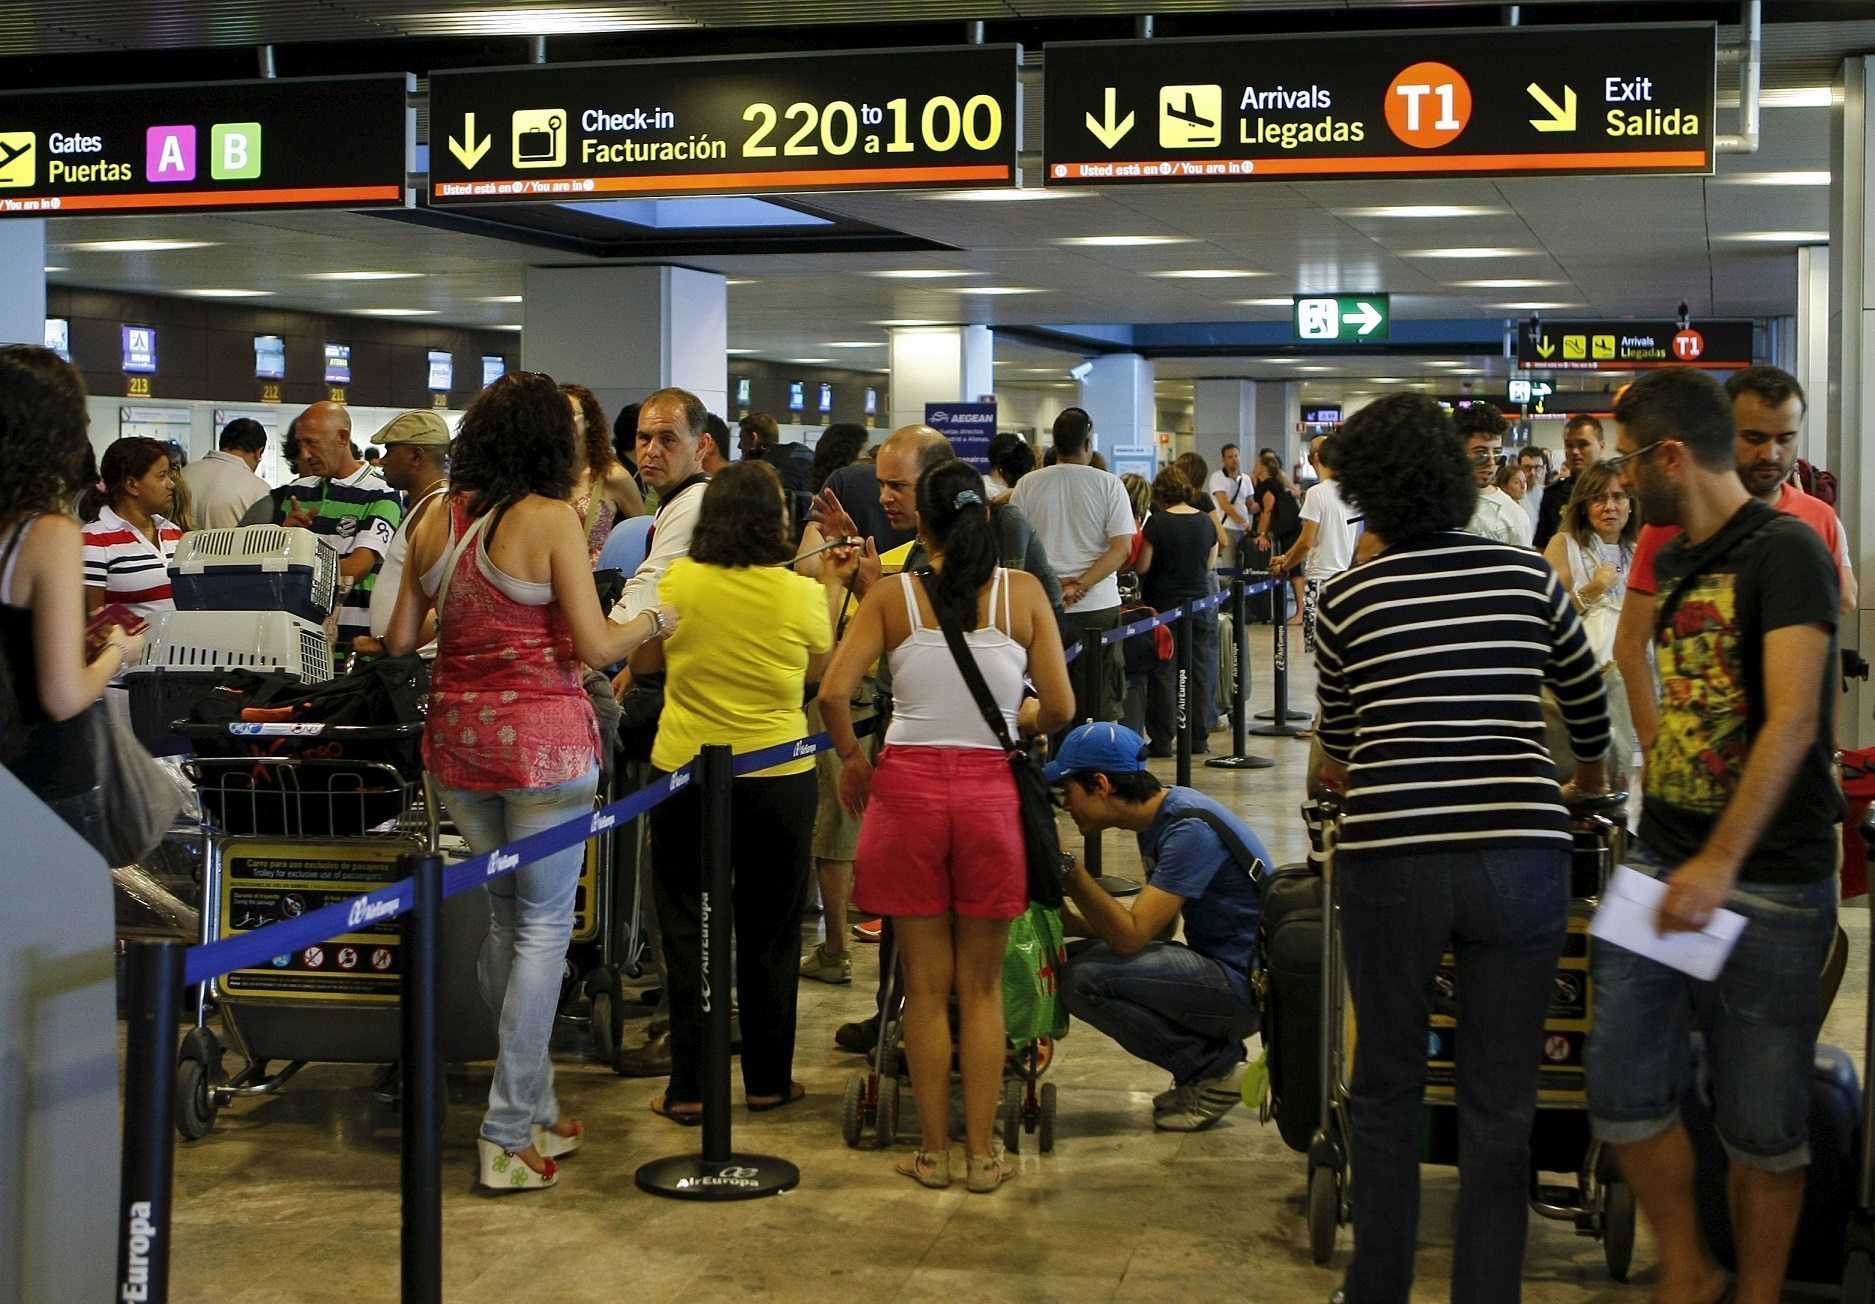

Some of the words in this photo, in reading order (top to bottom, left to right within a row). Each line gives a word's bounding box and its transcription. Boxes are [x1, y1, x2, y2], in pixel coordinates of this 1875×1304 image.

[1605, 76, 1652, 102] Exit
[861, 103, 883, 125] to
[1240, 84, 1332, 110] Arrivals
[1396, 83, 1461, 132] T1
[581, 107, 674, 132] Check-in
[741, 101, 858, 159] 220
[885, 94, 1003, 153] 100
[1606, 107, 1700, 138] Salida
[1239, 115, 1365, 148] Llegadas
[48, 132, 102, 154] Gates
[157, 135, 186, 173] A
[223, 132, 250, 171] B
[582, 134, 726, 163] Facturación
[863, 135, 880, 155] a
[48, 159, 132, 184] Puertas
[1079, 164, 1113, 177] Usted
[1115, 163, 1141, 175] está
[1143, 165, 1159, 175] en
[1181, 162, 1203, 174] You
[1206, 164, 1226, 174] are
[443, 182, 472, 196] Usted
[474, 181, 497, 195] está
[498, 183, 512, 194] en
[531, 180, 550, 192] You
[552, 181, 570, 192] are
[4, 198, 23, 211] You
[23, 200, 40, 210] are
[1620, 347, 1666, 359] Llegadas
[1621, 335, 1655, 347] Arrivals
[1676, 336, 1700, 355] T1
[130, 378, 148, 393] 213
[263, 384, 280, 400] 212
[331, 388, 345, 402] 211
[950, 413, 994, 423] AEGEAN
[1177, 668, 1187, 710] AirEuropa
[701, 891, 712, 974] AirEuropa
[676, 1177, 760, 1188] AirEuropa
